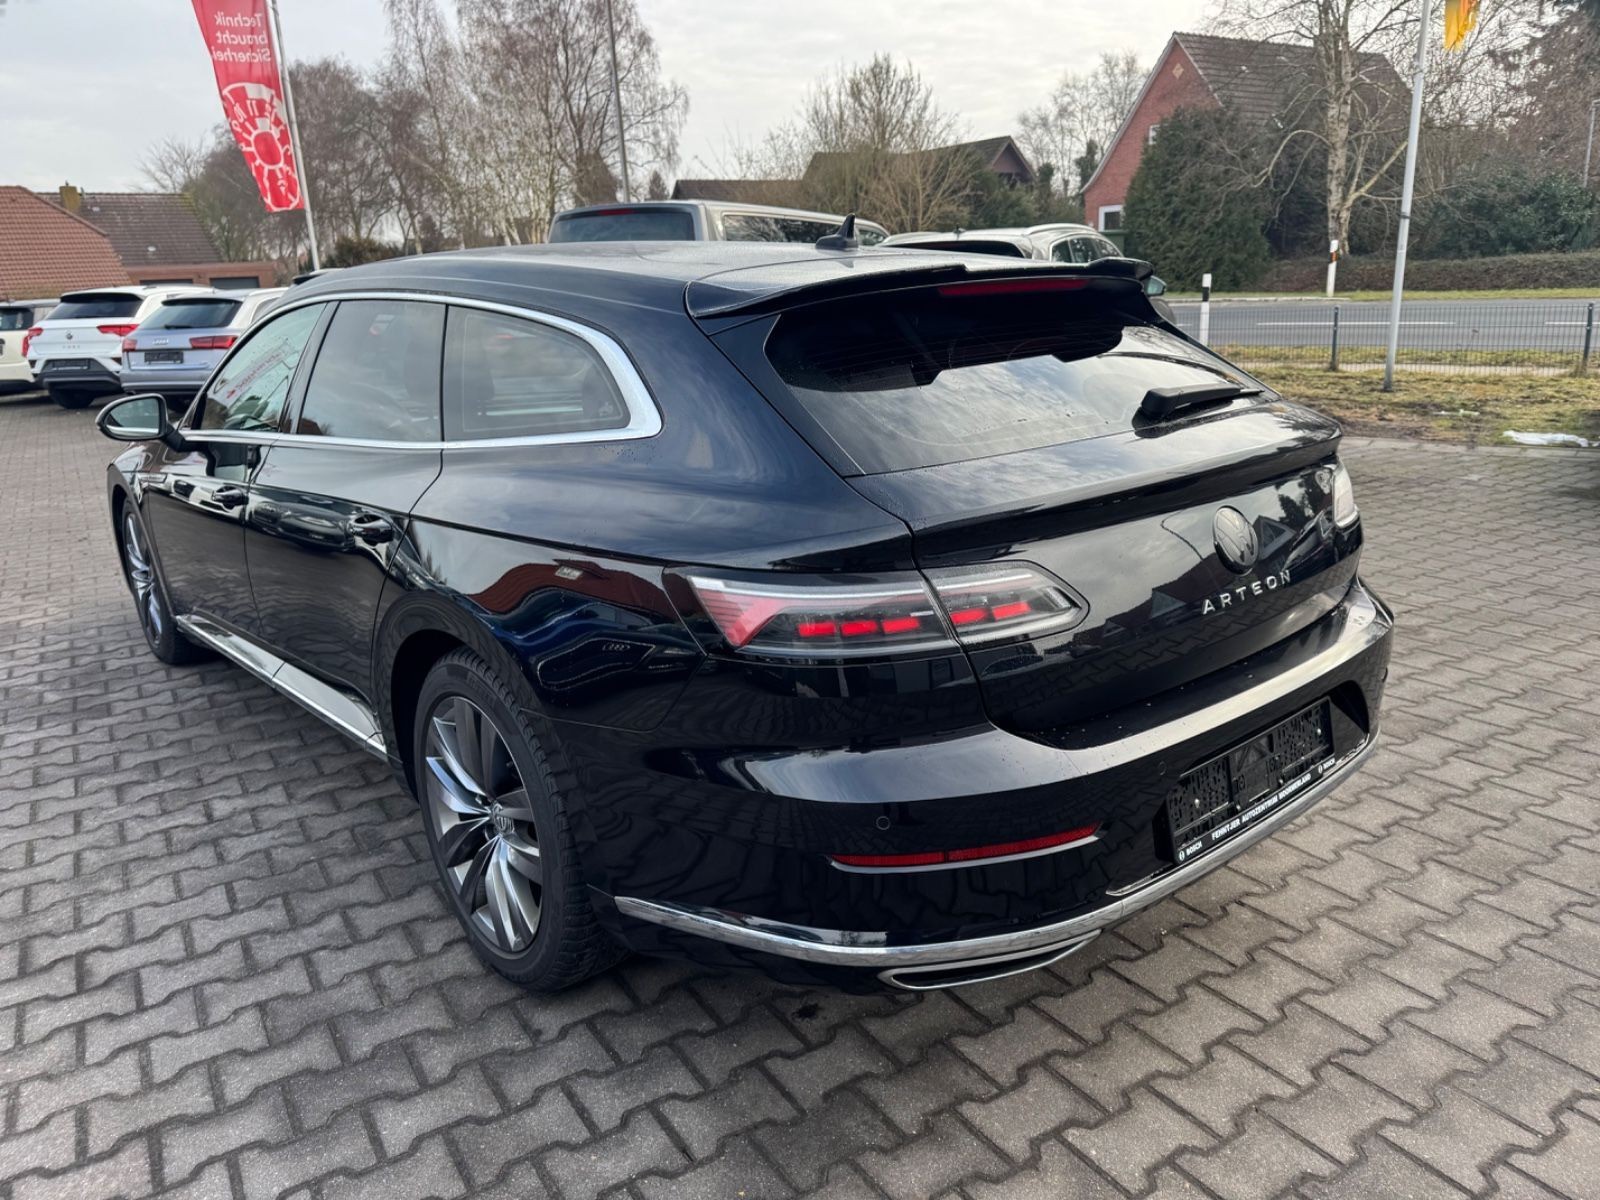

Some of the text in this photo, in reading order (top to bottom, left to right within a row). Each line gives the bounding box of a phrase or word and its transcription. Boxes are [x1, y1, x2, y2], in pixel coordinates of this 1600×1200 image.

[1202, 569, 1291, 615] ARTEON
[1241, 795, 1278, 823] AUTOZENTRUM
[1186, 841, 1203, 856] BOSCH
